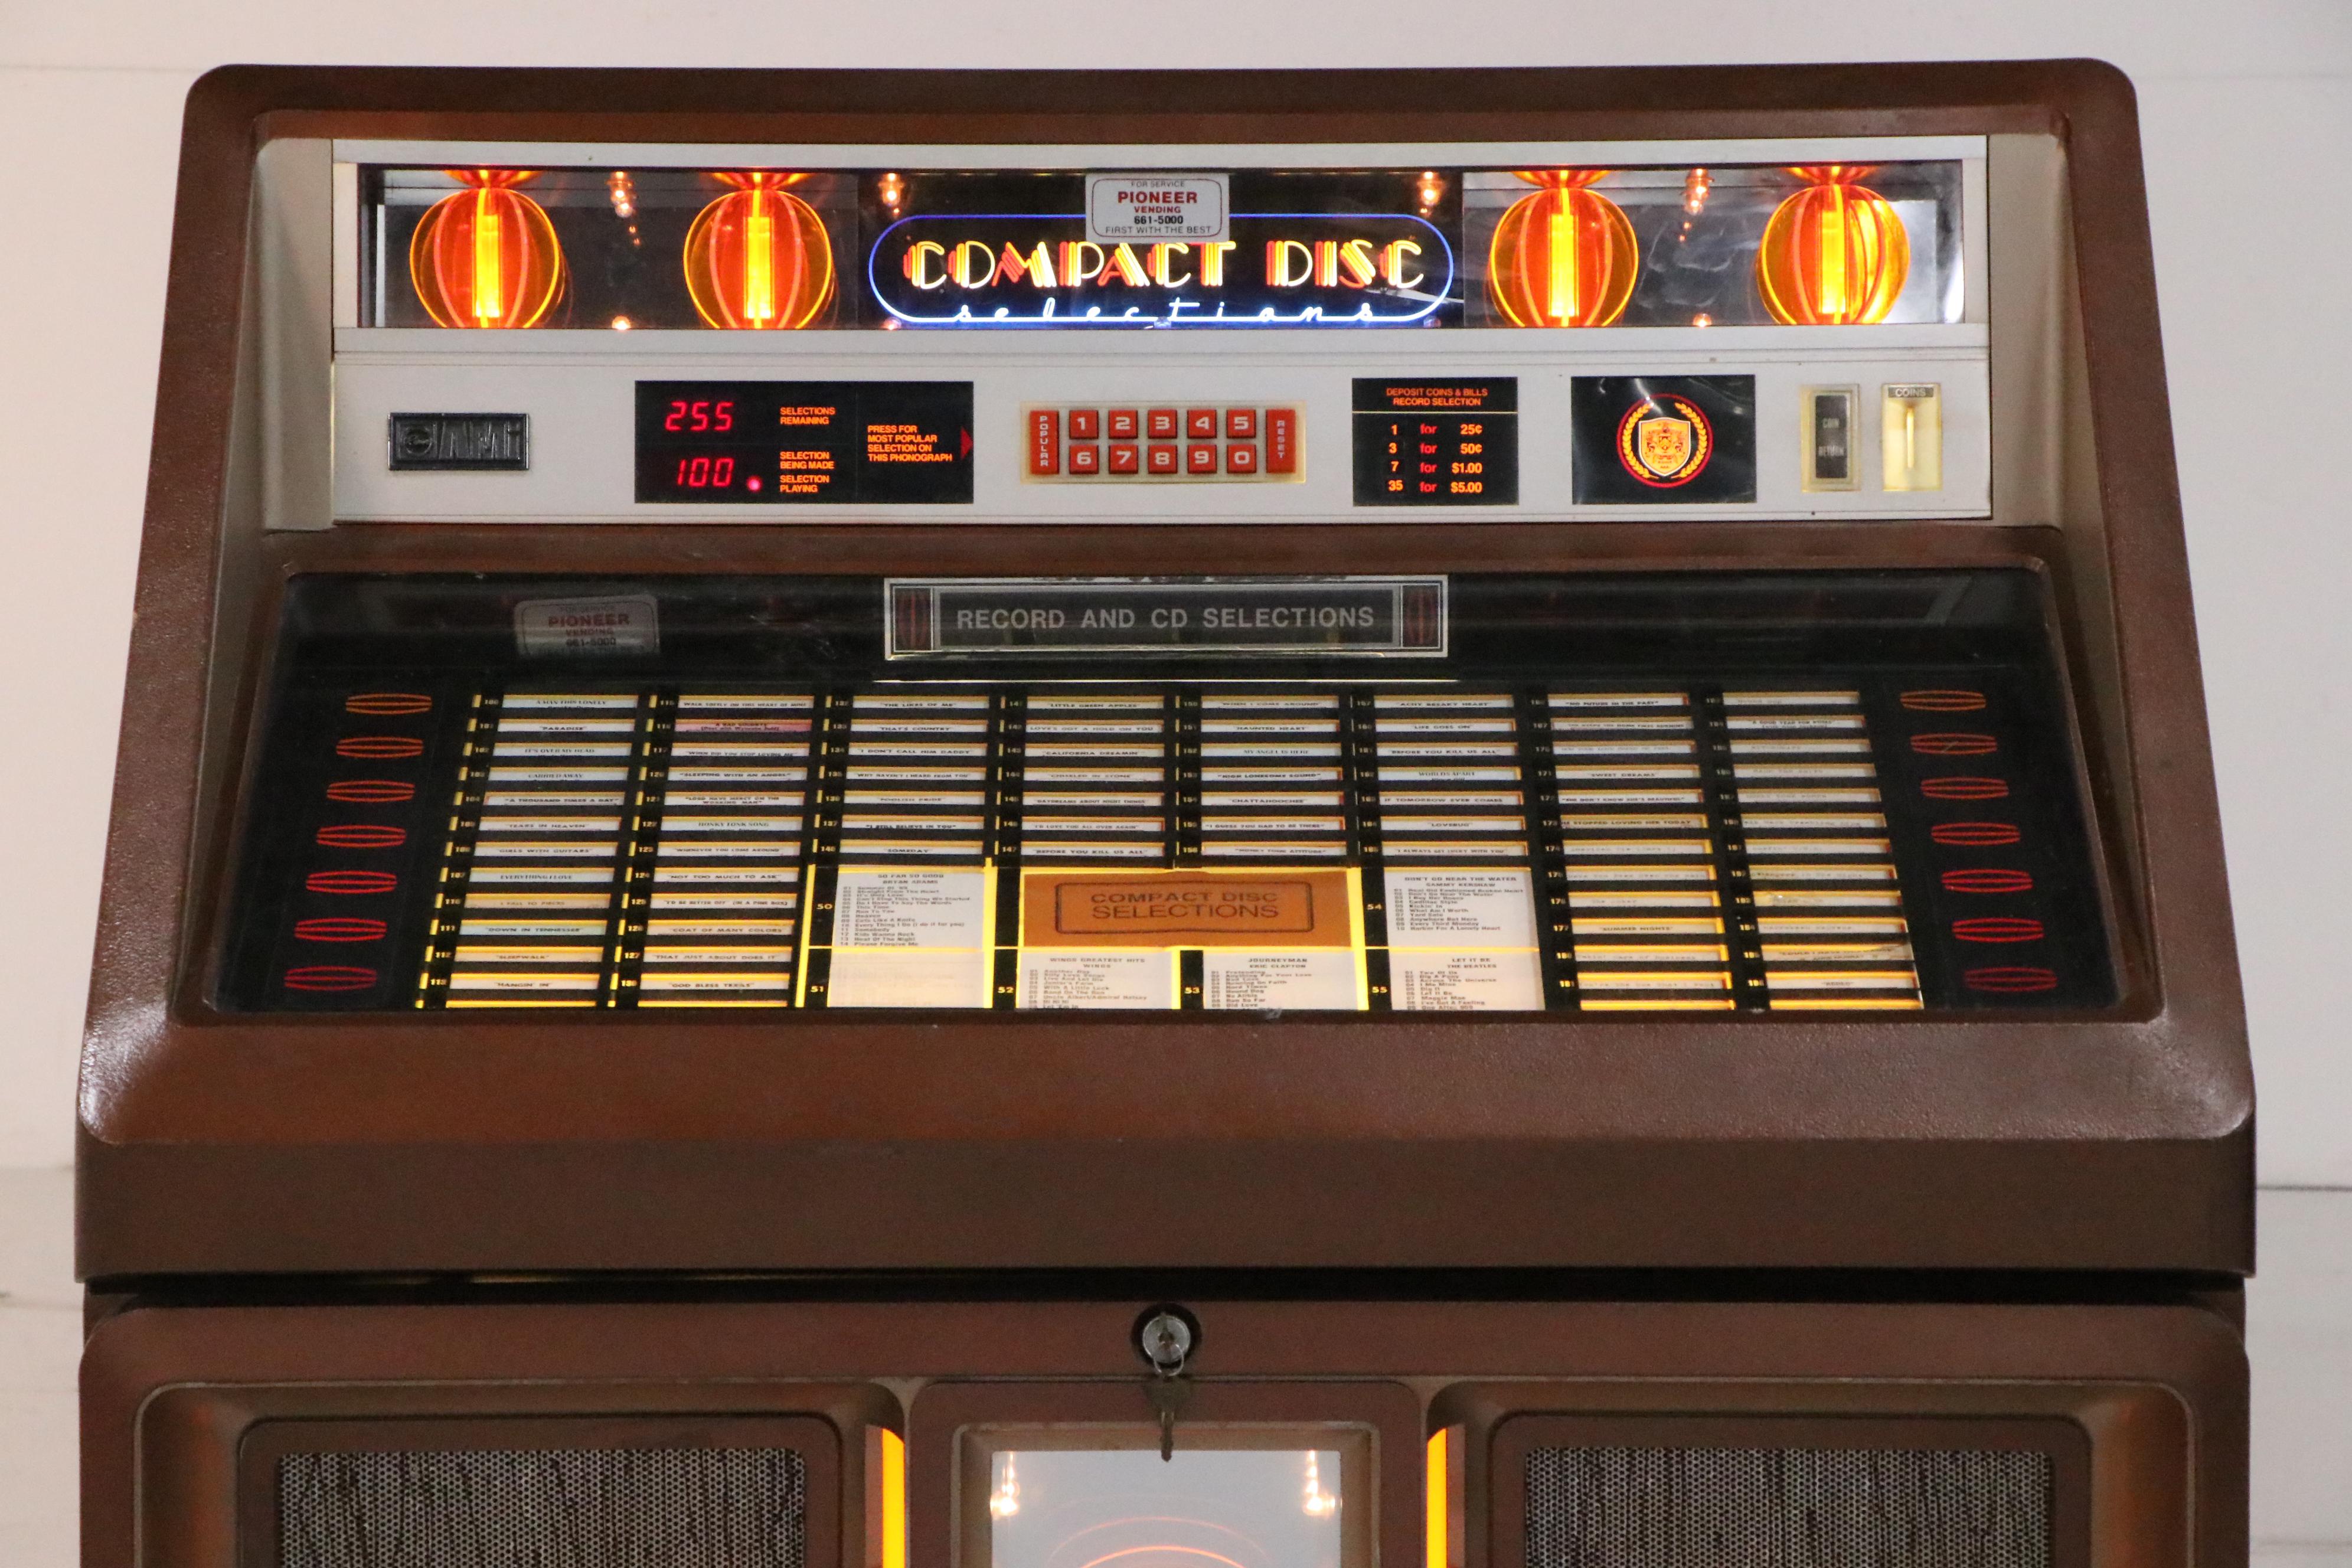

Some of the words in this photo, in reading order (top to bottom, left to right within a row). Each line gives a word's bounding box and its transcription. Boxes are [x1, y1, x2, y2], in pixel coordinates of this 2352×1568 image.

[1118, 191, 1197, 204] PIONEER
[1134, 215, 1183, 224] 661-5000
[903, 240, 1237, 289] COMPACT
[1266, 240, 1423, 289] DISC
[955, 296, 1374, 323] selections
[1386, 388, 1424, 396] DEPOSIT
[1426, 388, 1453, 396] COINS
[1455, 388, 1461, 396] &
[1463, 388, 1488, 396] BILLS
[1895, 388, 1926, 397] COINS
[664, 401, 734, 430] 255
[1077, 417, 1086, 430] 1
[1116, 417, 1131, 430] 2
[1155, 417, 1170, 430] 3
[1195, 417, 1209, 430] 4
[1234, 417, 1249, 430] 5
[1390, 424, 1398, 435] 1
[1420, 423, 1438, 434] for
[1460, 424, 1482, 435] 25¢
[867, 435, 893, 443] MOST
[895, 435, 937, 443] POPULAR
[1040, 415, 1049, 467] POPULAR
[1277, 420, 1285, 459] RESET
[867, 444, 917, 452] SELECTION
[919, 444, 932, 452] ON
[1389, 443, 1397, 453] 3
[1420, 443, 1438, 453] for
[1460, 443, 1482, 454] 50¢
[868, 453, 888, 462] THIS
[890, 453, 952, 462] PHONOGRAPH
[1077, 452, 1092, 465] 6
[1117, 452, 1131, 465] 7
[1155, 452, 1170, 465] 8
[1194, 452, 1209, 465] 9
[1234, 452, 1250, 465] 0
[780, 461, 807, 469] BEING
[808, 461, 835, 469] MADE
[1390, 460, 1399, 472] 7
[1420, 462, 1438, 473] for
[1451, 462, 1482, 474] $1.00
[677, 458, 734, 487] 100
[1388, 480, 1403, 491] 35
[1420, 482, 1438, 492] for
[1451, 481, 1482, 493] $5.00
[548, 613, 630, 628] PIONEER
[957, 609, 1065, 629] RECORD
[1080, 608, 1135, 629] AND
[1151, 608, 1187, 628] CD
[1203, 607, 1374, 628] SELECTIONS
[1091, 892, 1213, 903] COMPACT
[1222, 892, 1278, 902] DISC
[1093, 904, 1279, 919] SELECTIONS
